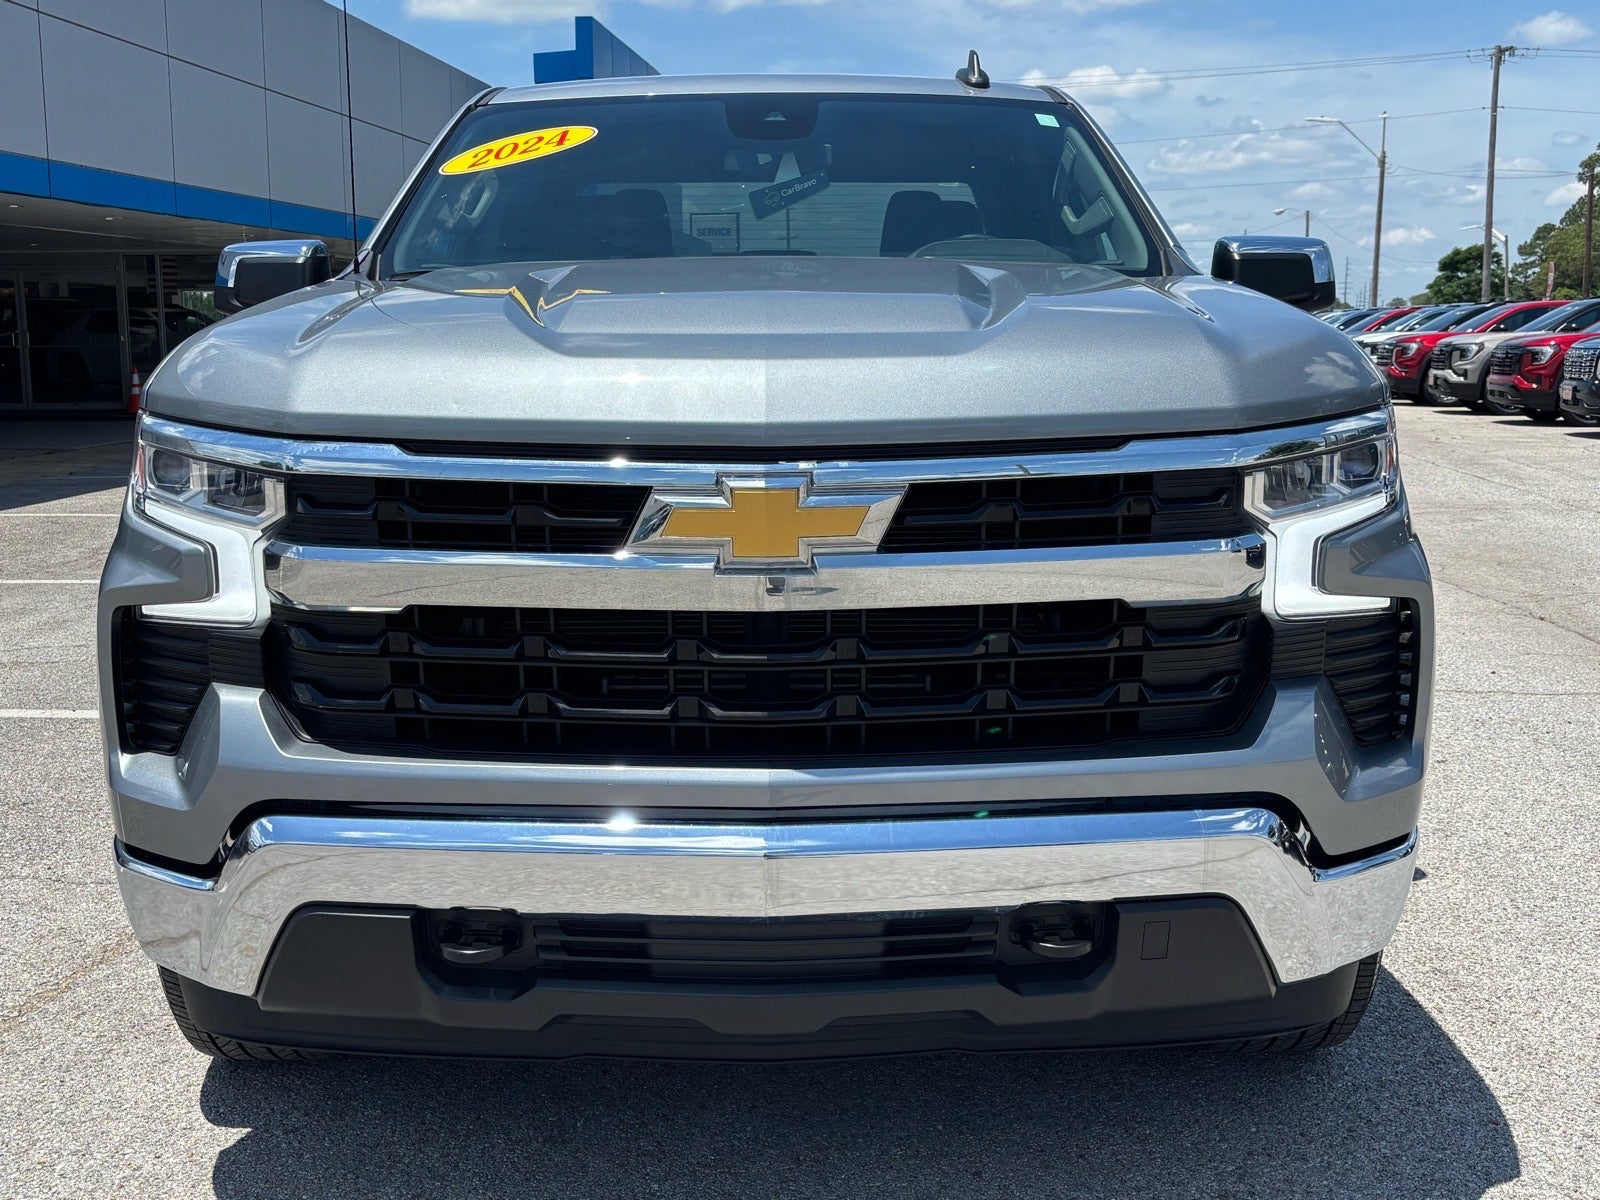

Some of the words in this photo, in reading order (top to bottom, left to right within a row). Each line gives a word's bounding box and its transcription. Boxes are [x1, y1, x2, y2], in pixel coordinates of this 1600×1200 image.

[467, 130, 570, 169] 2024
[781, 178, 817, 197] CarBravo
[696, 227, 732, 237] SERVICE
